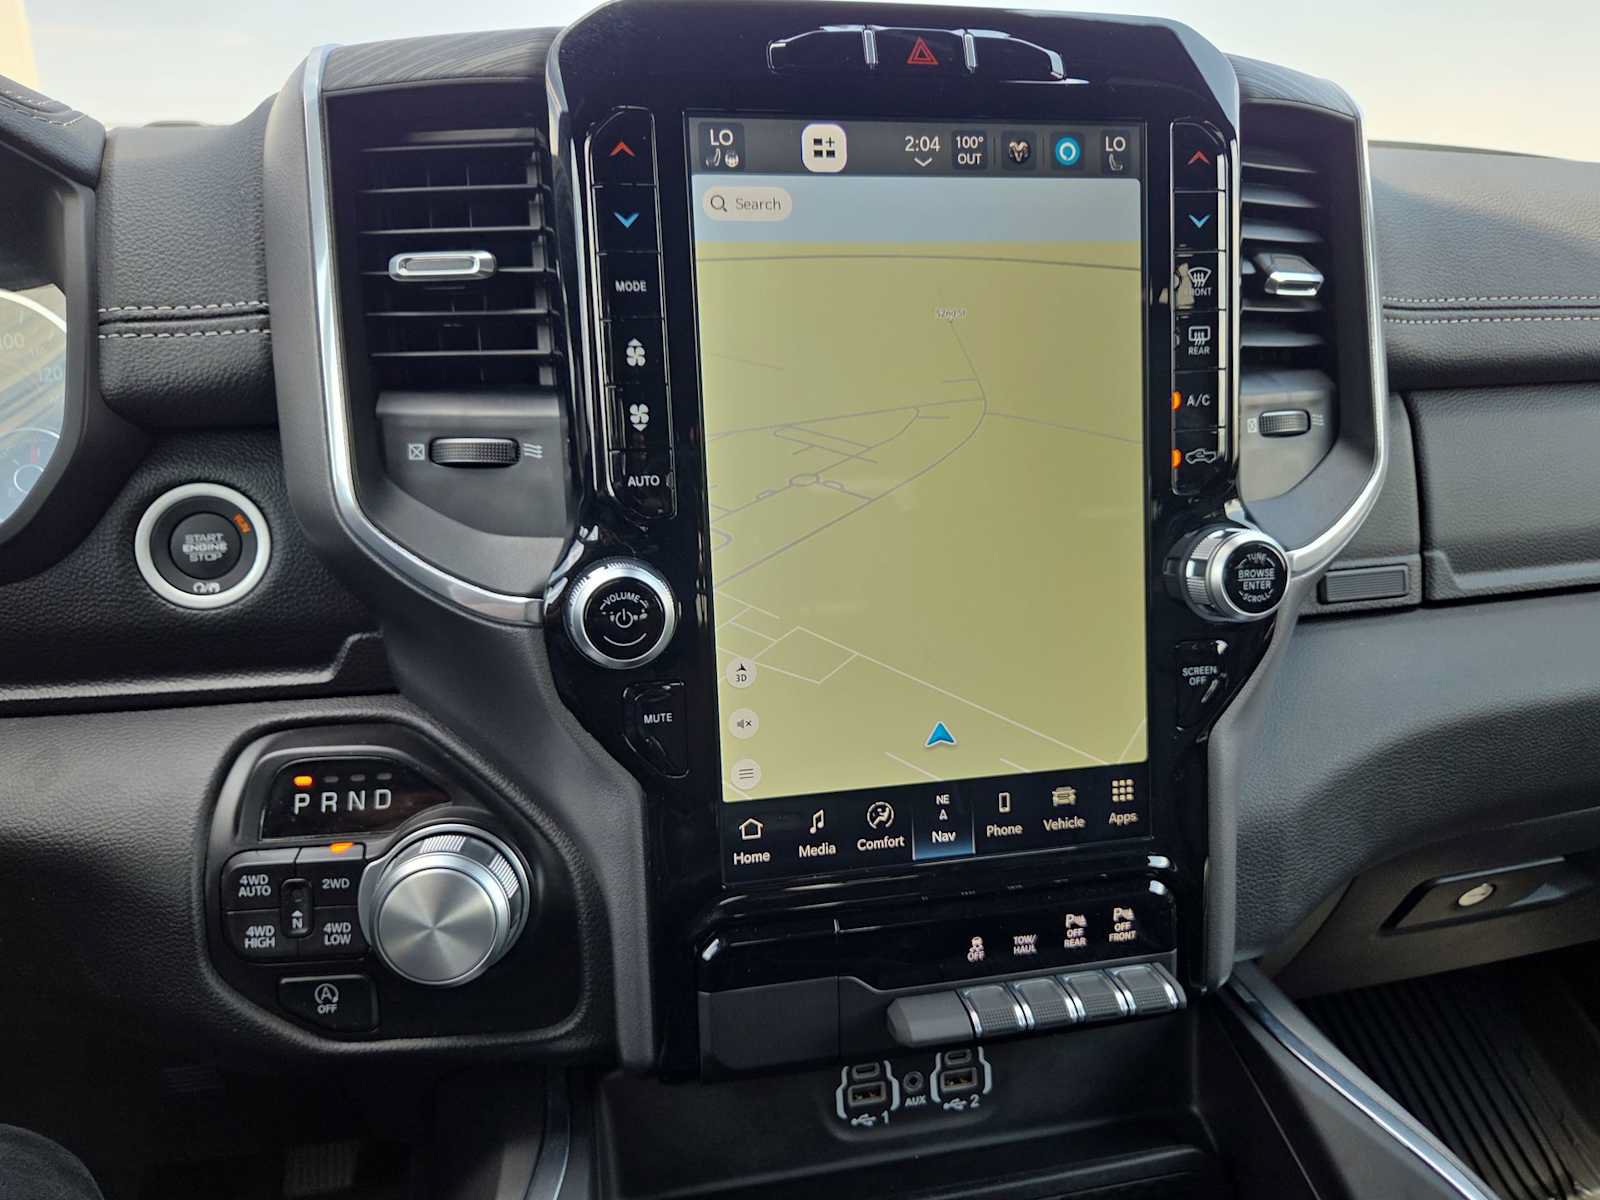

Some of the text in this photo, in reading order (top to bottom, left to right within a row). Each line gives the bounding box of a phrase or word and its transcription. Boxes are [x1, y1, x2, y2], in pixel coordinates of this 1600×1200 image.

[709, 128, 734, 146] LO
[955, 136, 984, 149] 100°
[904, 136, 940, 152] 2:04
[1105, 136, 1126, 152] LO
[957, 153, 982, 165] OUT
[735, 197, 782, 211] Search
[615, 281, 647, 292] MODE
[1188, 346, 1211, 355] REAR
[1186, 394, 1211, 407] A/C
[627, 475, 661, 487] AUTO
[184, 533, 224, 543] START
[182, 542, 228, 553] ENGINE
[189, 552, 223, 562] STOP
[1246, 552, 1267, 561] TUNE
[1238, 568, 1275, 578] BROWSE
[1243, 580, 1271, 591] ENTER
[604, 591, 640, 605] VOLUME
[1242, 592, 1271, 602] SCROLL
[1182, 666, 1217, 677] SCREEN
[736, 674, 747, 682] 3D
[1189, 676, 1207, 686] OFF
[643, 712, 672, 724] MUTE
[293, 788, 392, 815] P R N D
[936, 794, 950, 805] NE
[1042, 816, 1086, 831] Vehicle
[1108, 811, 1138, 825] Apps
[931, 830, 956, 844] Nav
[986, 824, 1023, 838] Phone
[856, 835, 905, 852] Comfort
[798, 843, 837, 858] Media
[733, 851, 771, 865] Home
[239, 873, 269, 886] 4WD
[321, 878, 350, 890] 2WD
[238, 885, 271, 898] AUTO
[291, 918, 303, 929] N
[323, 922, 351, 934] 4WD
[1114, 922, 1131, 932] OFF
[245, 925, 275, 937] 4WD
[1067, 928, 1085, 938] OFF
[1109, 931, 1137, 943] FRONT
[244, 937, 275, 949] HIGH
[324, 933, 351, 946] LOW
[1013, 934, 1037, 945] TOW/
[1064, 938, 1087, 948] REAR
[1013, 944, 1037, 955] HAUL
[967, 952, 985, 962] OFF
[317, 1004, 337, 1014] OFF
[905, 1095, 927, 1107] AUX
[970, 1094, 981, 1108] 2
[881, 1110, 890, 1125] 1
